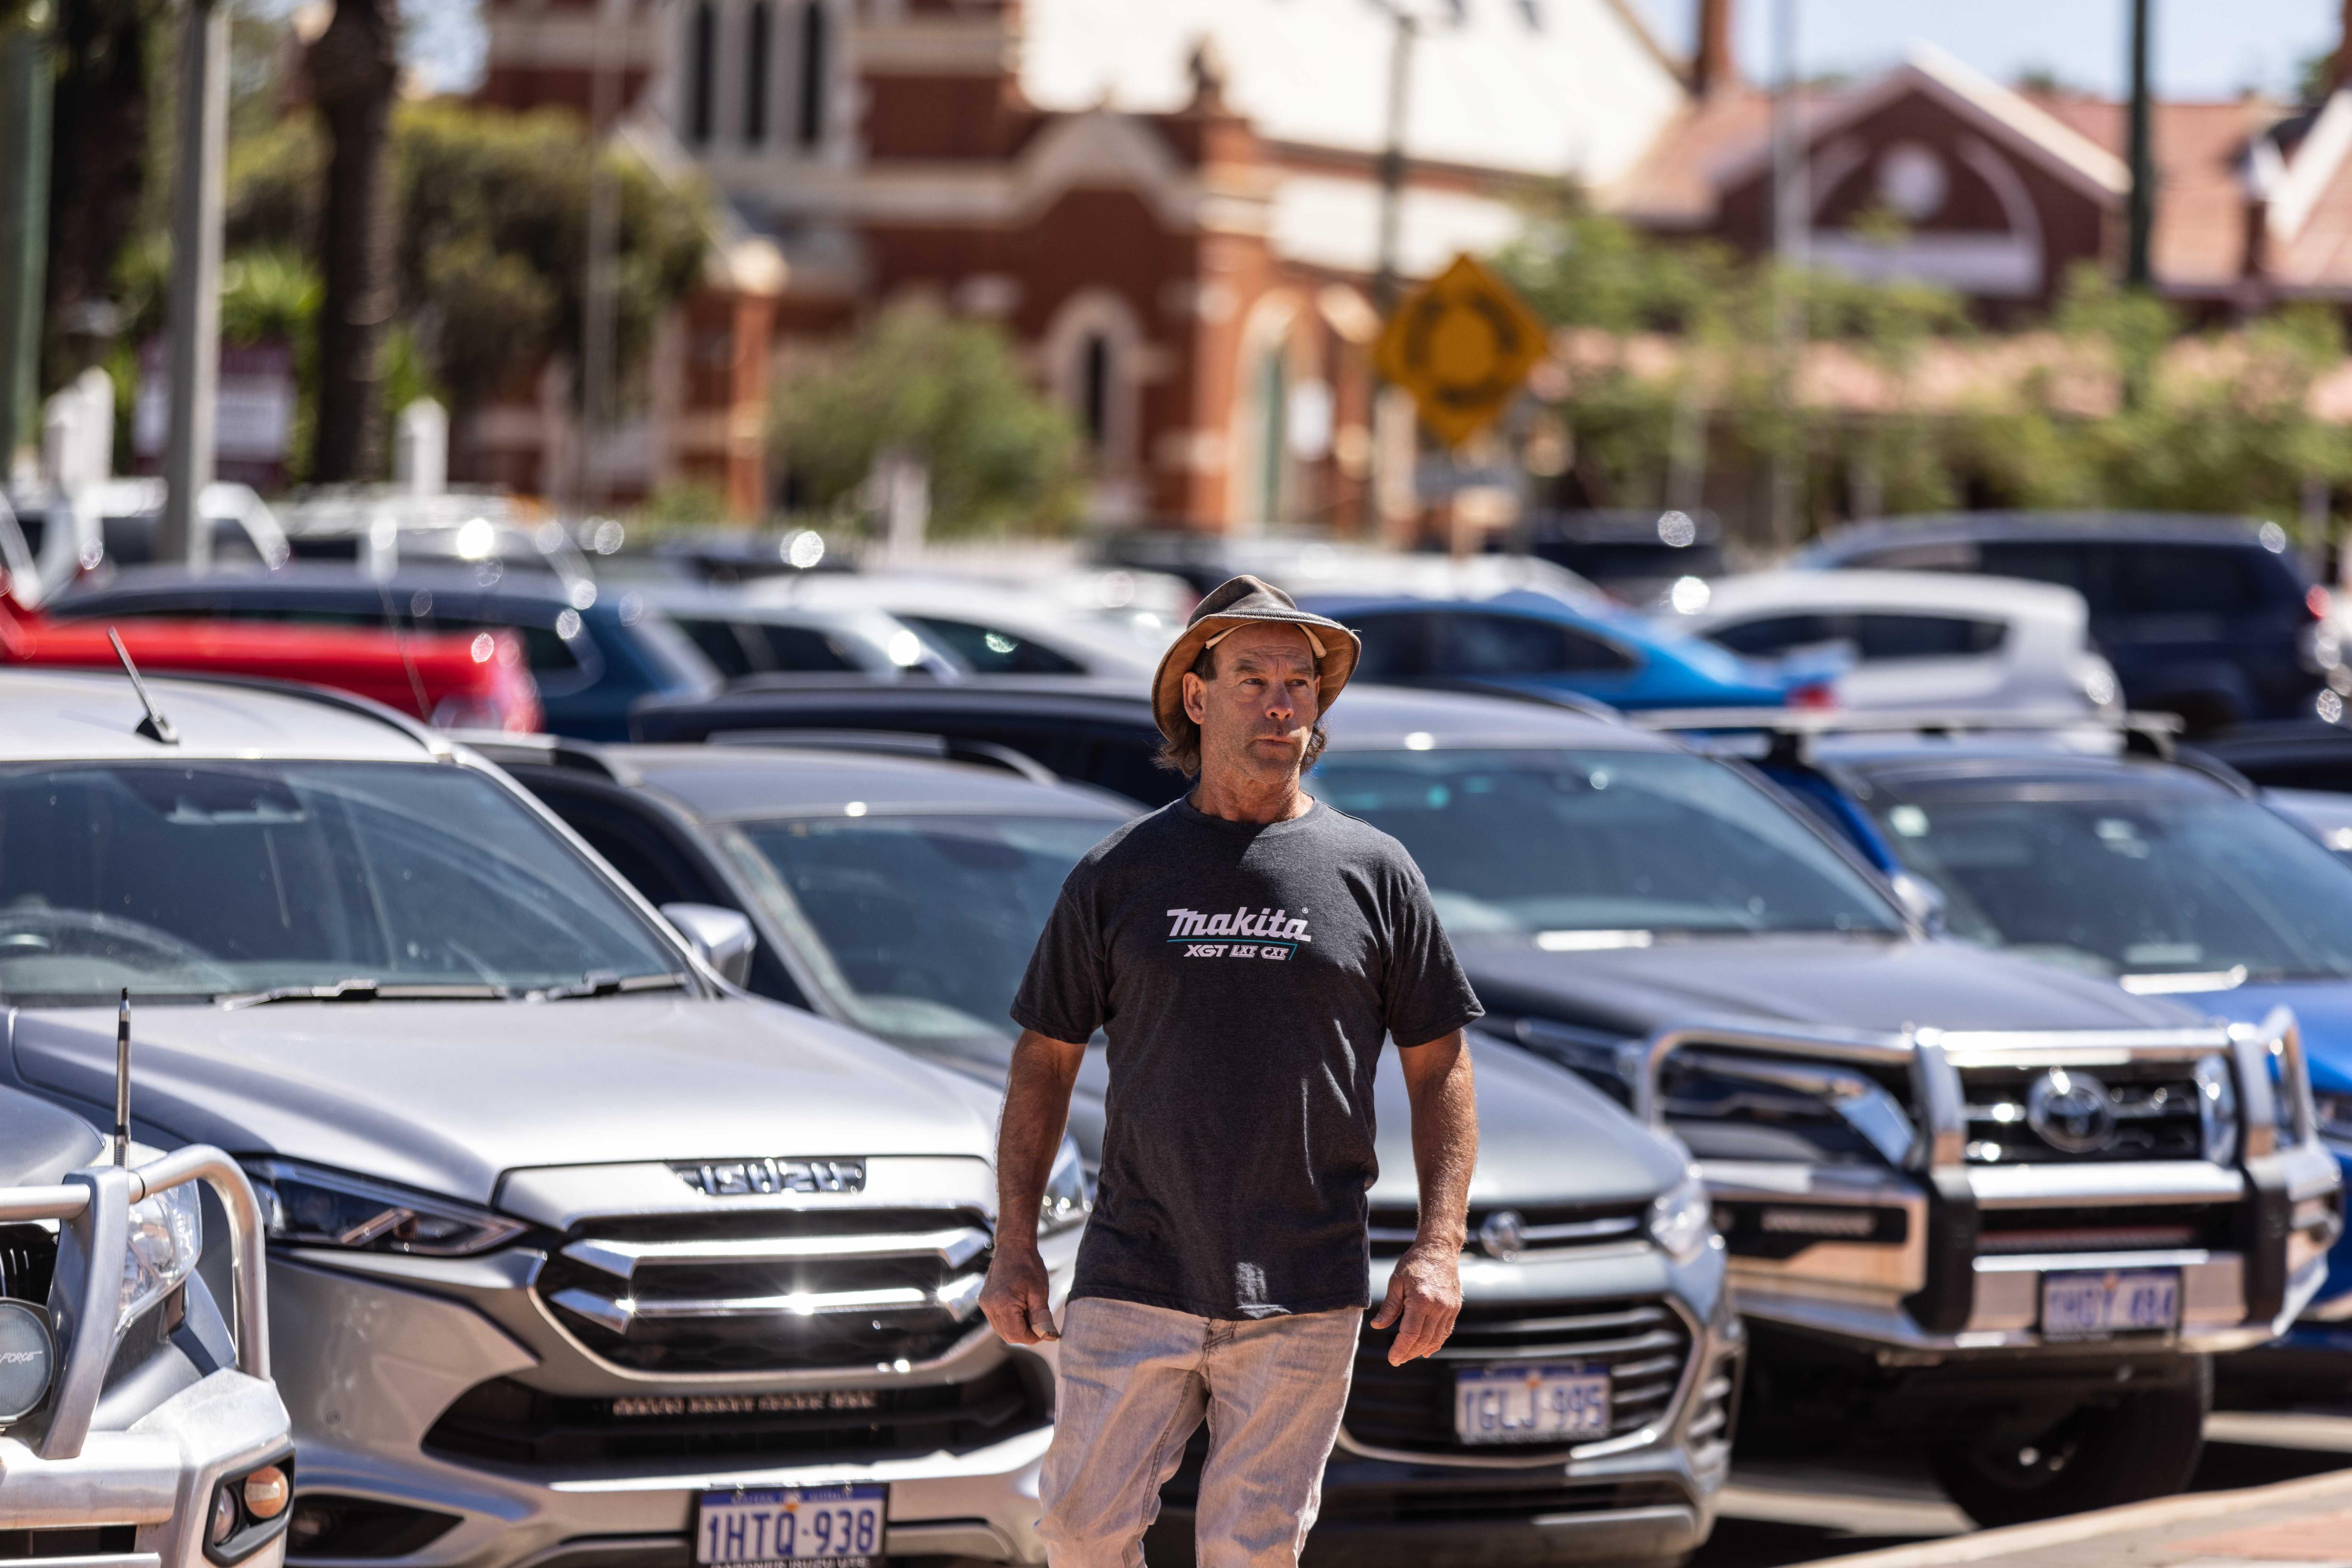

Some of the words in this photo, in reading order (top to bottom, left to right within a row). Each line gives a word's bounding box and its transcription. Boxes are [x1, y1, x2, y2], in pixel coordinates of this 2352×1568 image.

[1183, 944, 1229, 957] XGT
[1229, 945, 1258, 958] LXT
[1260, 946, 1289, 960] CXT
[700, 1163, 844, 1195] ISUZU
